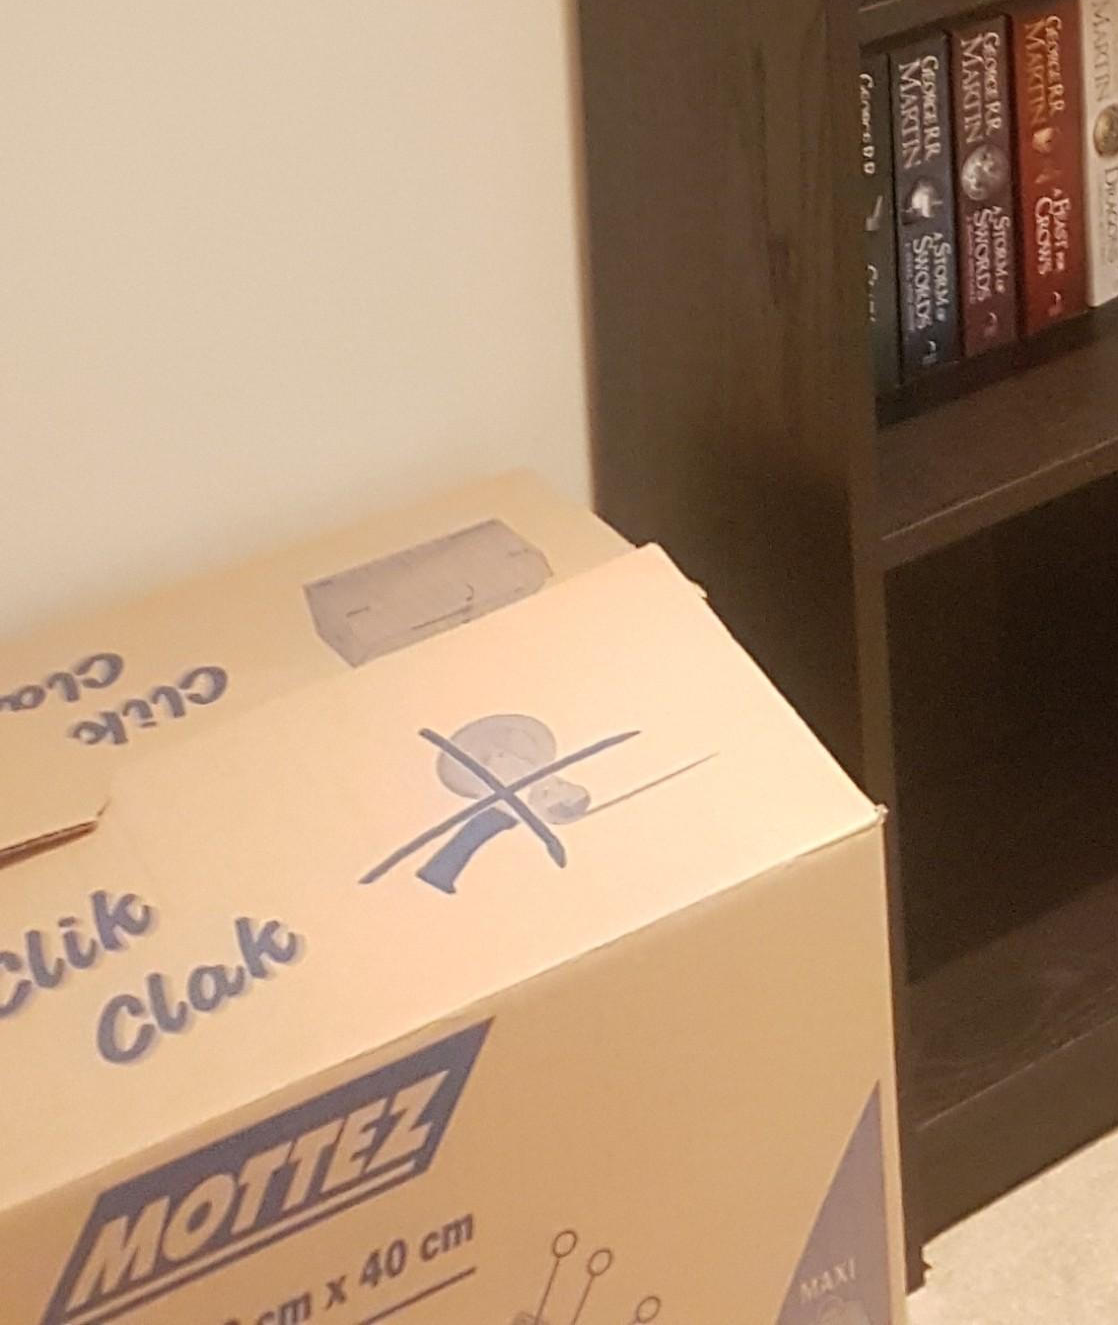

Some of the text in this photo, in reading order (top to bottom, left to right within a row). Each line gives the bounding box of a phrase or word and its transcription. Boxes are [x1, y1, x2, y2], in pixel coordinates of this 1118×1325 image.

[917, 54, 939, 126] GEORGE
[960, 33, 984, 144] MARTIN
[1024, 18, 1048, 128] MARTIN
[1092, 0, 1112, 104] MARTIN
[898, 58, 923, 170] MARTIN
[973, 207, 995, 303] SWORDS
[992, 216, 1011, 275] STORM
[1034, 196, 1054, 276] CROWS
[1052, 197, 1071, 250] FEAST
[911, 235, 934, 331] SWORDS
[933, 242, 952, 306] STORM
[68, 665, 228, 745] Clik
[95, 916, 298, 1064] Clak
[66, 1069, 451, 1312] MOTTEZ
[358, 1238, 408, 1289] 40
[418, 1212, 474, 1263] cm
[799, 1257, 857, 1302] MAXI
